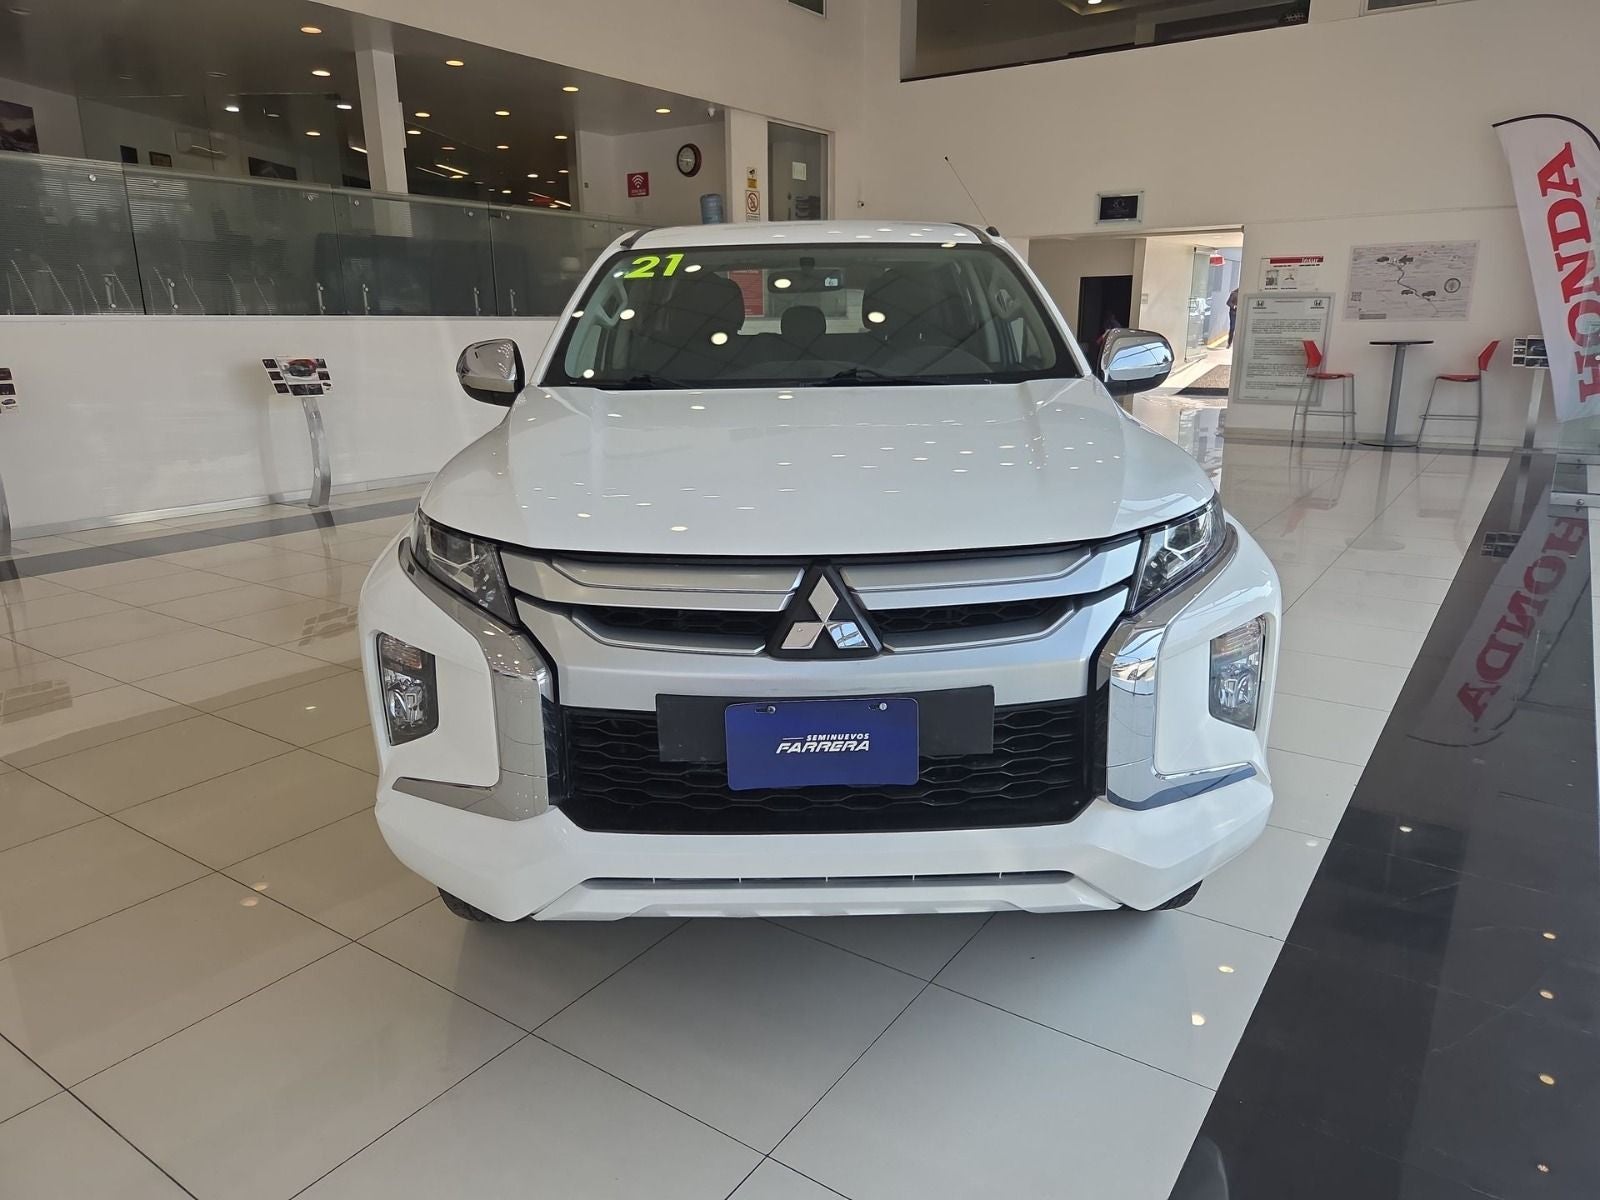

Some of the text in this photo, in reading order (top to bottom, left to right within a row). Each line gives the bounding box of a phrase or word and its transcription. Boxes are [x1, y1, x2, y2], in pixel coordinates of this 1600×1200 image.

[623, 253, 684, 279] 21
[1537, 141, 1600, 403] HONDA
[806, 733, 869, 741] SEMINUEVOS
[775, 741, 869, 753] FARRERA
